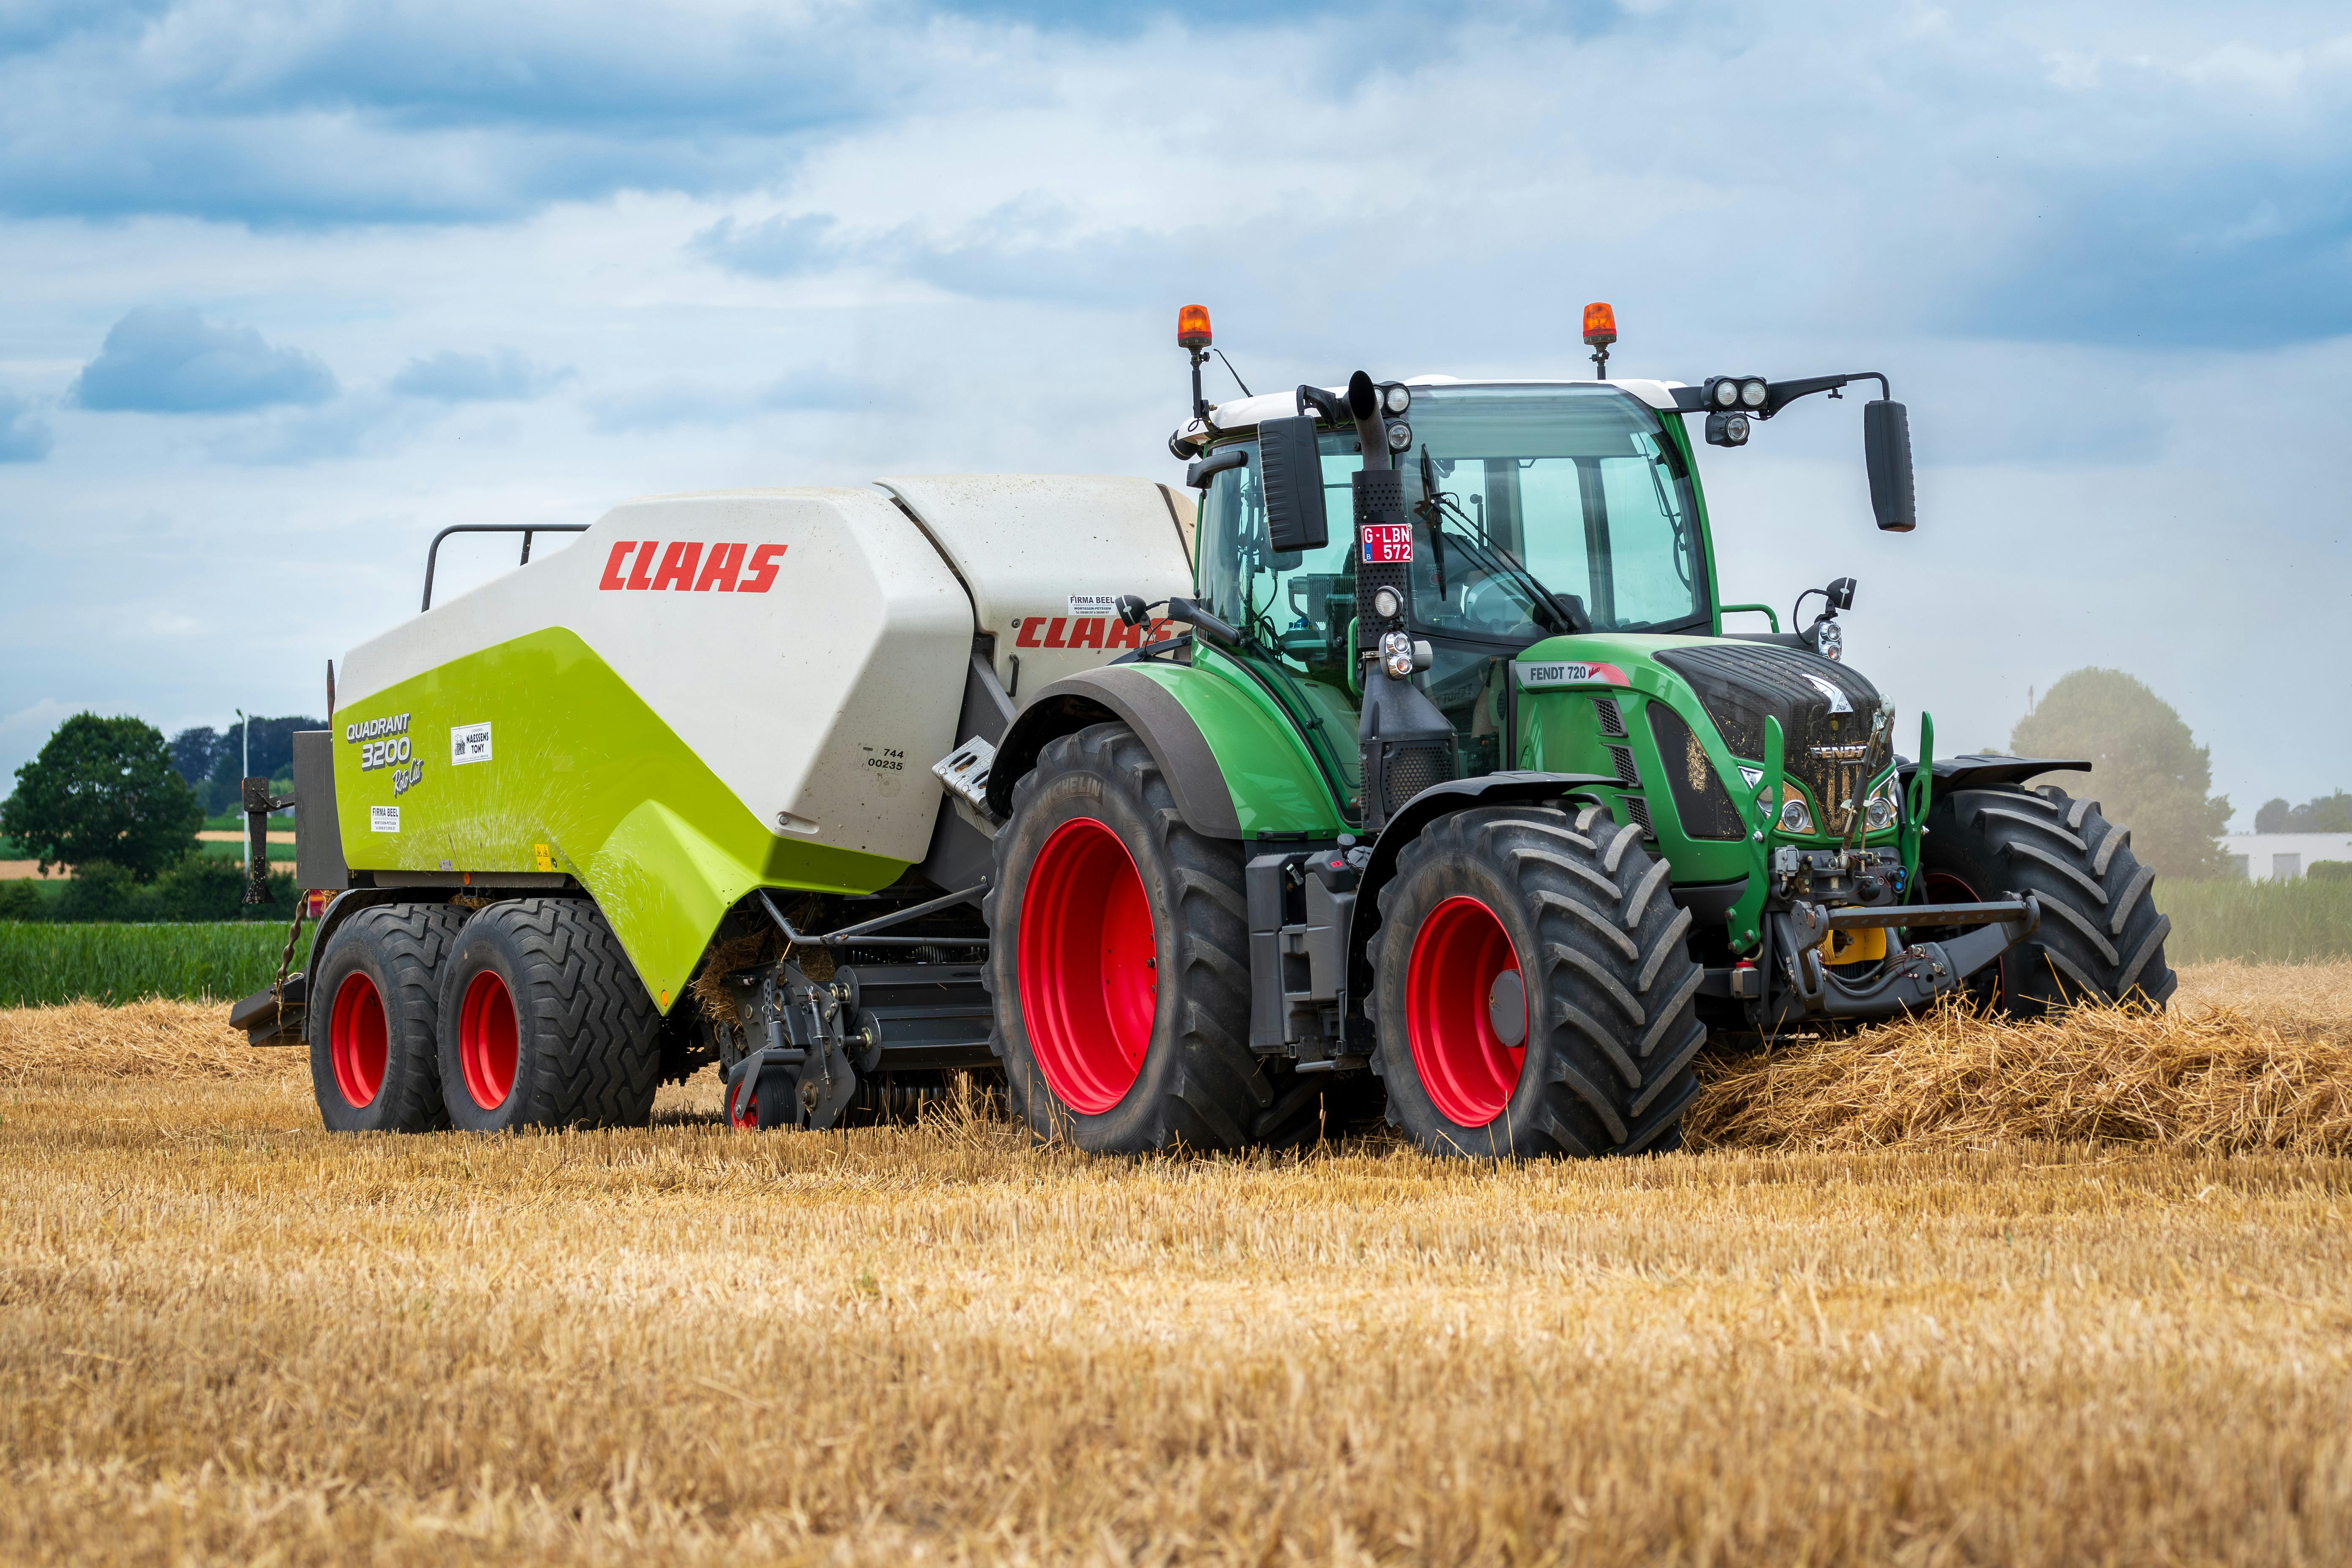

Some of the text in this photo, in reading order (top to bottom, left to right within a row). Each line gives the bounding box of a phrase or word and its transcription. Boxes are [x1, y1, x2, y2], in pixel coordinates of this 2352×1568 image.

[1364, 527, 1410, 543] G-LBN
[1383, 544, 1411, 560] 572
[599, 541, 789, 593] CLAAS
[1015, 617, 1175, 648] CLAAS
[1530, 667, 1564, 681] FENDT
[1568, 666, 1586, 679] 720
[346, 713, 411, 743] QUADRANT
[466, 732, 489, 744] NAESSENS
[361, 736, 412, 772] 3200
[471, 743, 485, 754] TONY
[884, 748, 904, 759] 744
[1810, 746, 1867, 759] FENDT
[868, 758, 904, 770] 00235
[392, 757, 425, 799] Roto Cut
[1037, 777, 1102, 818] MICHELIN
[373, 808, 398, 817] FIRMA BEEL
[386, 988, 397, 1088] VREDESTEIN
[438, 994, 451, 1091] VREDESTEIN
[511, 973, 528, 1094] FLOTATION
